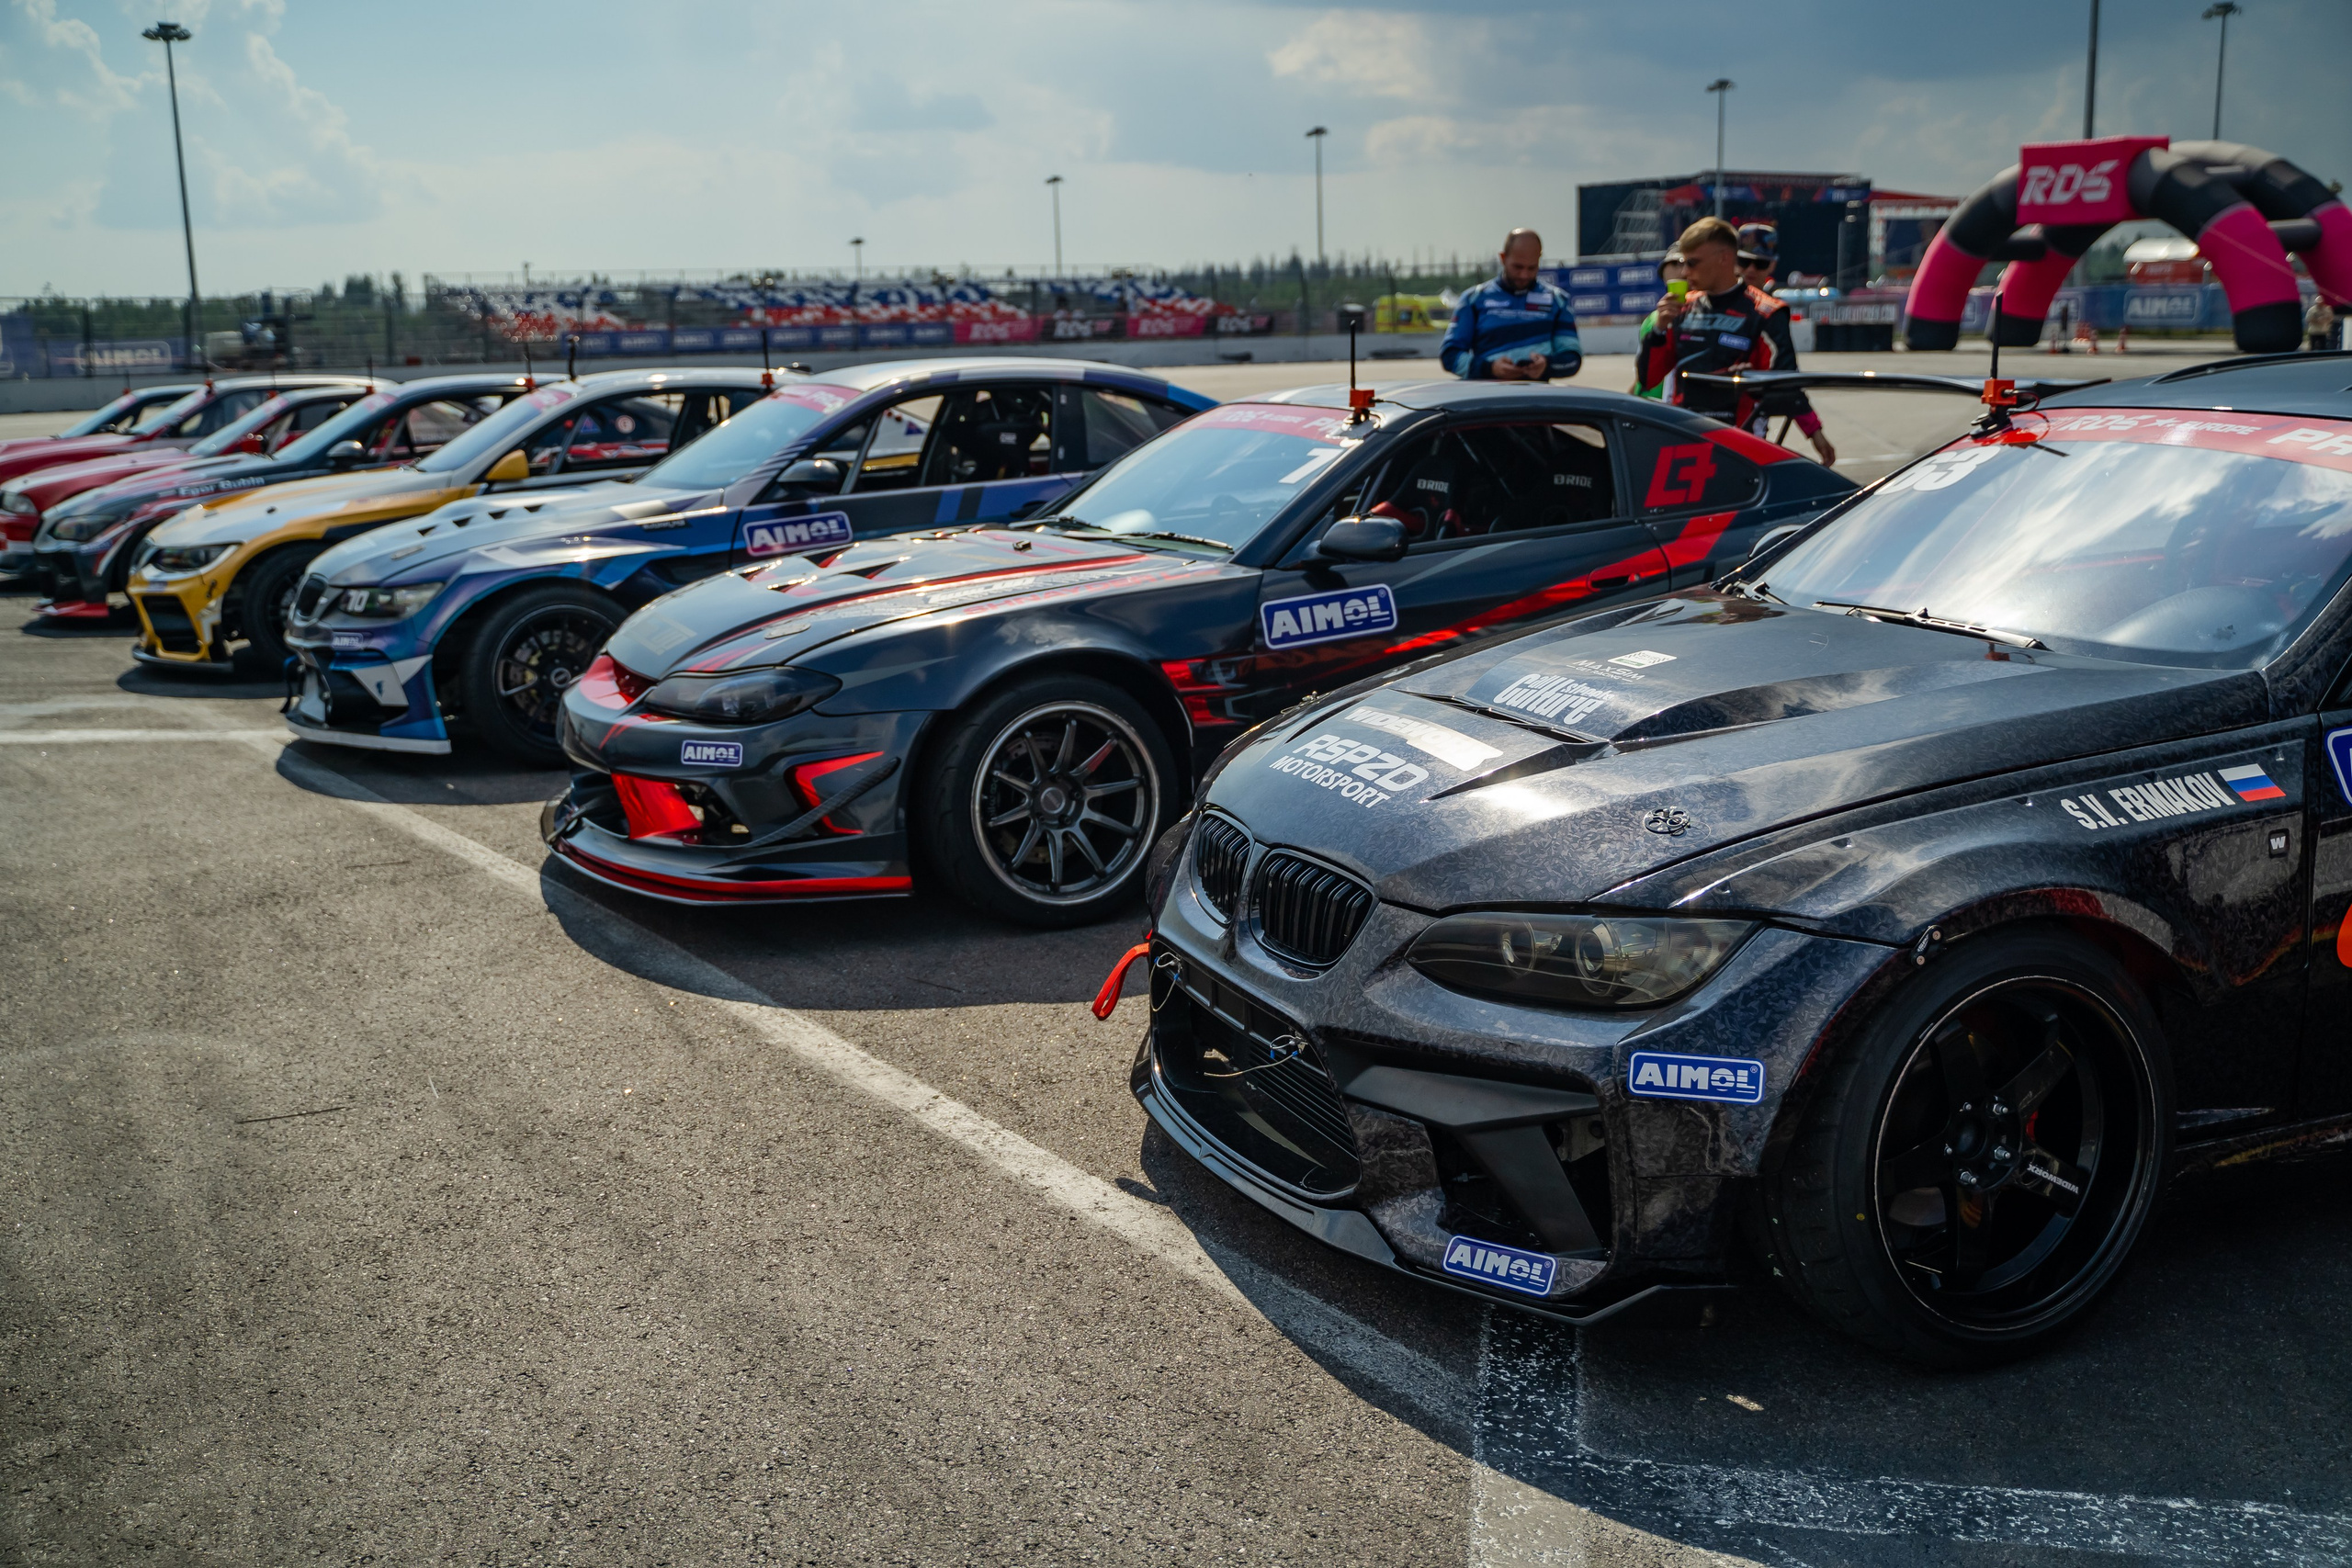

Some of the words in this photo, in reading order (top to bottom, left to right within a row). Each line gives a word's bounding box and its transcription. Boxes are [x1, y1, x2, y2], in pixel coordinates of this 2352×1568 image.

[2019, 159, 2119, 206] RDS
[2126, 297, 2193, 317] AIMOL
[2055, 414, 2157, 431] RDS
[2177, 420, 2263, 435] EUROPE
[1278, 447, 1344, 484] 1
[752, 519, 848, 549] AIMOL
[1270, 595, 1391, 639] AIMOL
[684, 745, 740, 762] AIMOL
[1343, 707, 1494, 766] WIDEWO
[1268, 755, 1392, 809] MOTORSPORT
[1292, 734, 1430, 793] RSPZD
[2060, 793, 2129, 830] S.V.
[2107, 772, 2236, 823] ERMAKOV
[1634, 1061, 1758, 1094] AIMOL
[2027, 1163, 2079, 1194] WIDEWORX
[1448, 1243, 1546, 1287] AIMOL
